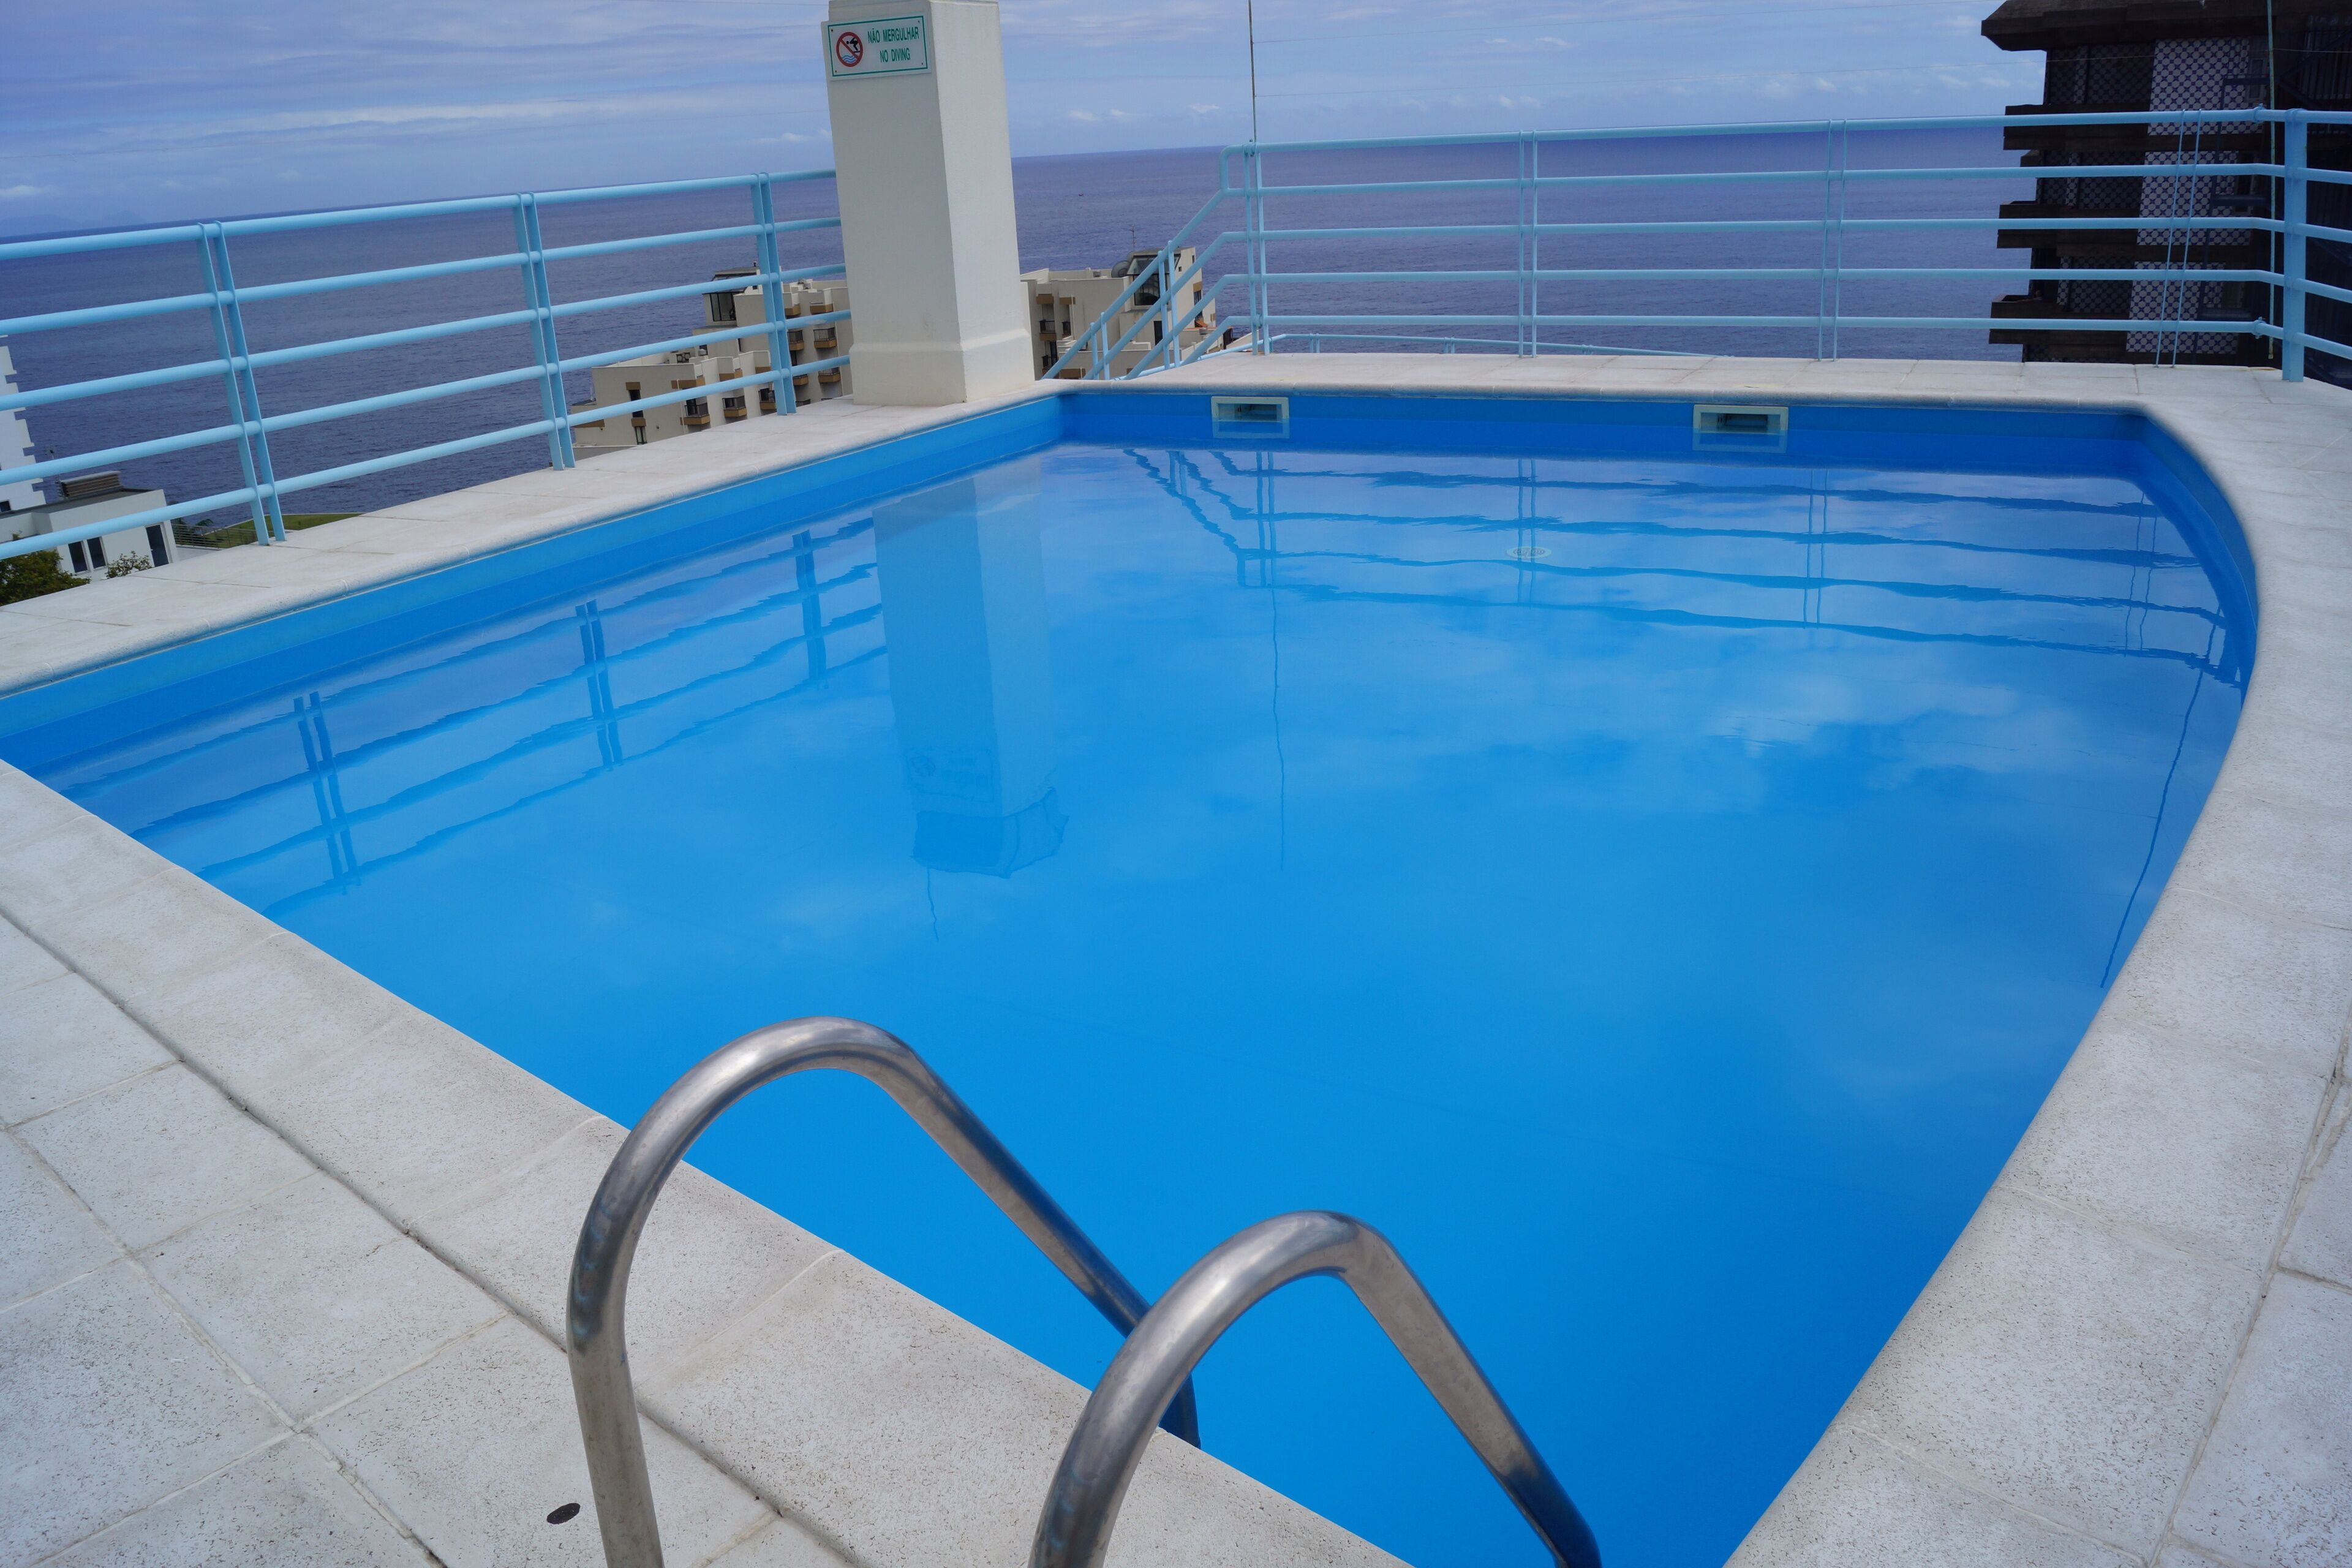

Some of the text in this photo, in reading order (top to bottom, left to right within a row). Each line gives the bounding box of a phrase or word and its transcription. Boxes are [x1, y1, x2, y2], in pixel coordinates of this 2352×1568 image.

[867, 26, 919, 43] NÃO MERGULHAR
[880, 48, 911, 62] NO DIVING
